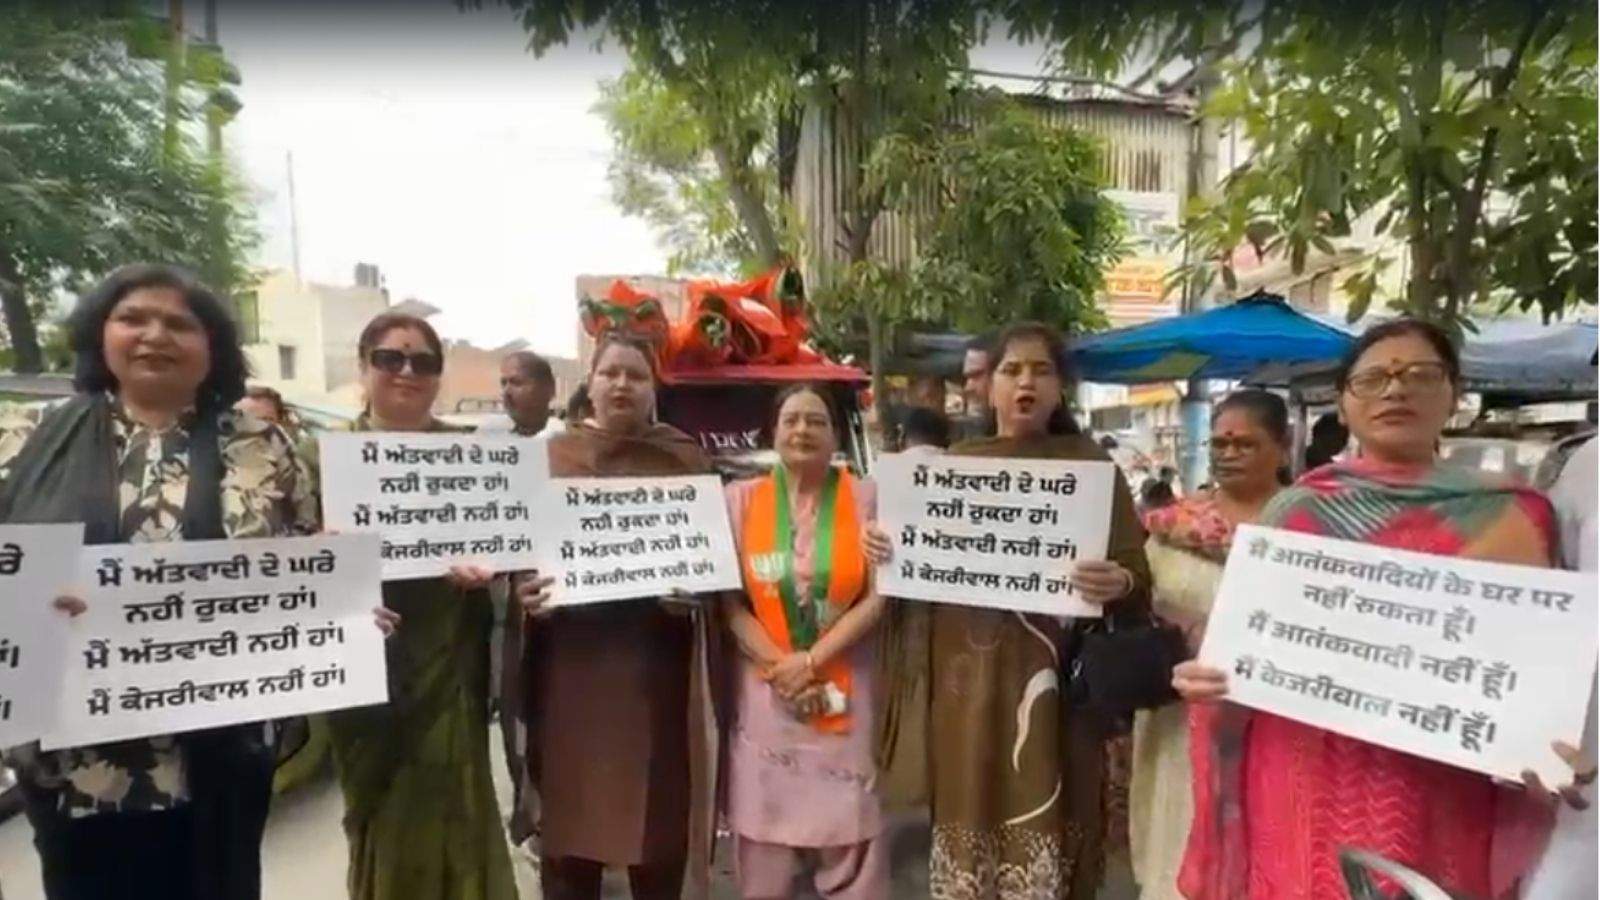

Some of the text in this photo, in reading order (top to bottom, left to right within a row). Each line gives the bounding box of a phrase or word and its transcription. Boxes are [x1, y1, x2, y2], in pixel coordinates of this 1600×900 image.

[934, 469, 1012, 493] ਅੱਤਵਾਦੀ
[1017, 472, 1034, 494] ਦੇ
[1039, 473, 1077, 496] ਘਰੇ
[926, 498, 1058, 526] ਨਹੀਂ ਰੁਕਦਾ ਹਾਂ।
[921, 529, 997, 554] ਅੱਤਵਾਦੀ
[1001, 535, 1042, 558] ਨਹੀਂ
[1045, 538, 1077, 560] ਹਾਂ।
[132, 554, 251, 584] ਅੱਤਵਾਦੀ
[258, 552, 280, 577] ਦੇ
[288, 549, 337, 575] ਘਰੇ
[918, 563, 1002, 589] ਕੇਜਰੀਵਾਲ
[1005, 571, 1042, 592] ਨਹੀਂ
[1045, 575, 1076, 595] ਹਾਂ।
[1272, 547, 1438, 592] आतंकवादियों
[1443, 572, 1474, 595] के
[1480, 581, 1525, 605] घर
[1531, 589, 1574, 612] पर
[123, 585, 317, 623] ਨਹੀਂ ਰੁਕਦਾ ਹਾਂ।
[1303, 584, 1477, 642] नहीं रुकता हूँ।
[119, 630, 239, 664] ਅੱਤਵਾਦੀ
[247, 622, 300, 653] ਨਹੀਂ
[306, 627, 344, 647] ਹਾਂ।
[1271, 618, 1416, 669] आतंकवादी
[1420, 653, 1480, 683] नहीं
[1482, 662, 1518, 700] हूँ।
[119, 680, 250, 711] ਕੇਜਰੀਵਾਲ
[257, 667, 305, 695] ਨਹੀਂ
[311, 665, 345, 688] ਹਾਂ।
[1260, 660, 1392, 717] केजरीवाल
[1398, 702, 1459, 733] नहीं
[1461, 712, 1497, 752] हूँ।
